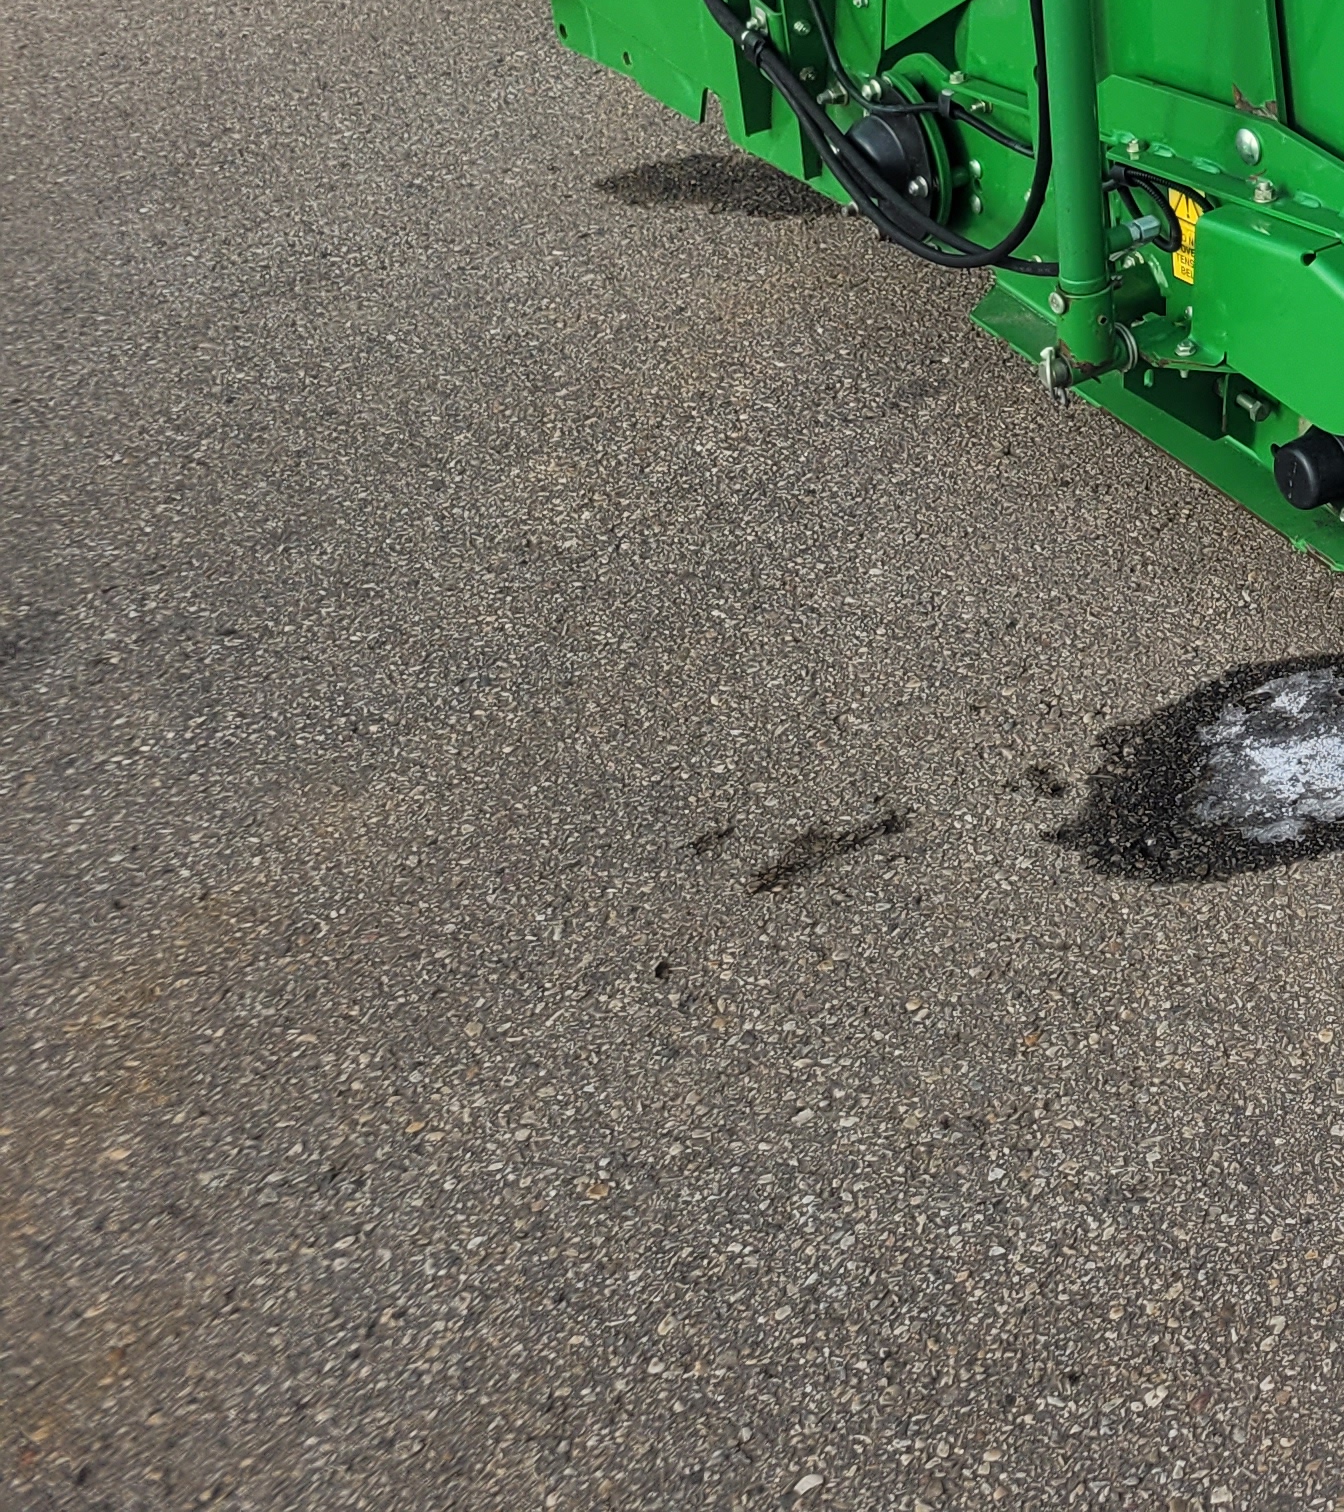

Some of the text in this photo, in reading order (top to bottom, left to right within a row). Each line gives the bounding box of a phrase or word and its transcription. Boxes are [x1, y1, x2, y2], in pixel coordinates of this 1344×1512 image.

[1181, 243, 1195, 257] OVE
[1176, 253, 1194, 268] TENS
[1180, 266, 1194, 279] BEL
